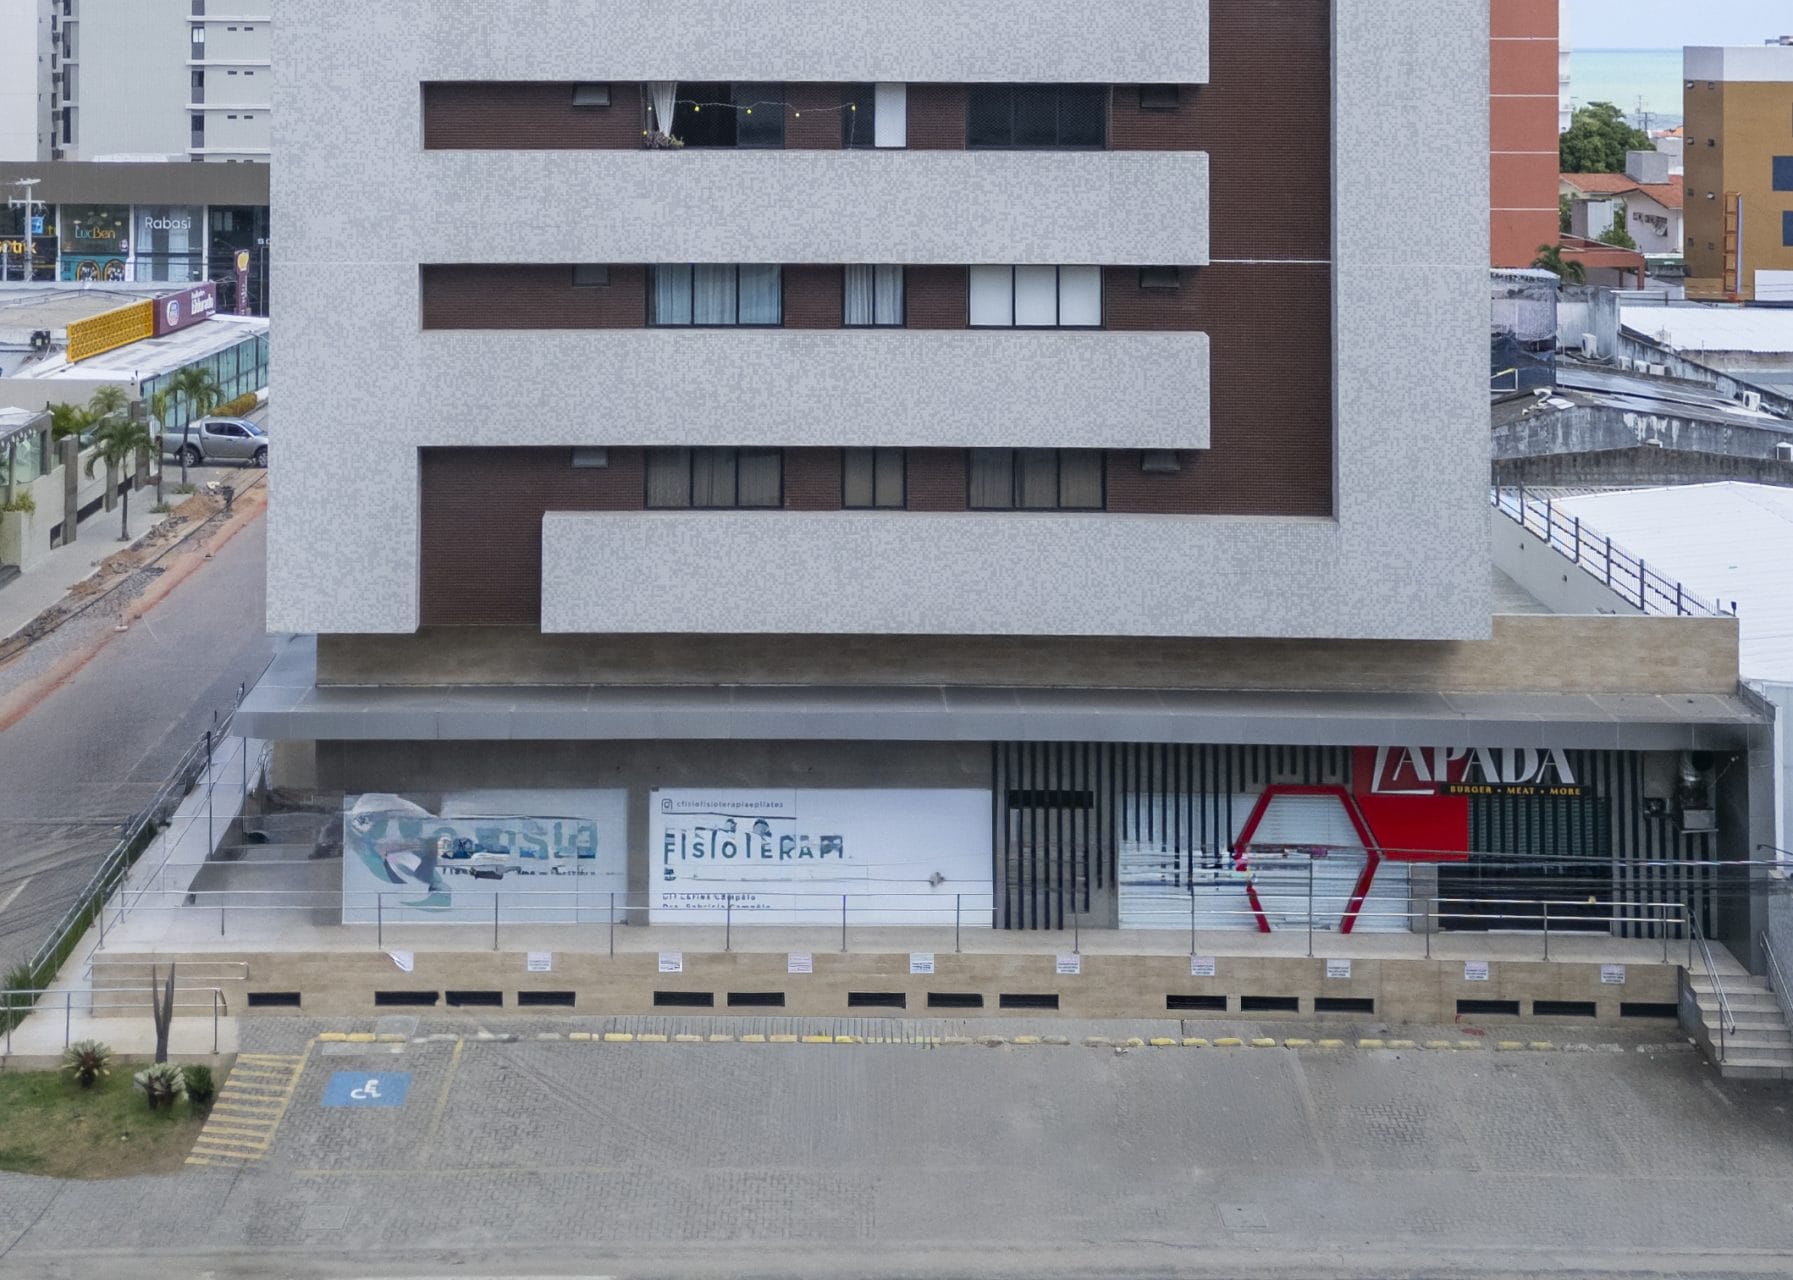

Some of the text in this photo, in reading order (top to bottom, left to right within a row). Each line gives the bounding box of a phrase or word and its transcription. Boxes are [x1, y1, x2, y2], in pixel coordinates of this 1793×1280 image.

[145, 216, 192, 230] Rabasi
[1450, 785, 1582, 796] BURGER MEAT MORE
